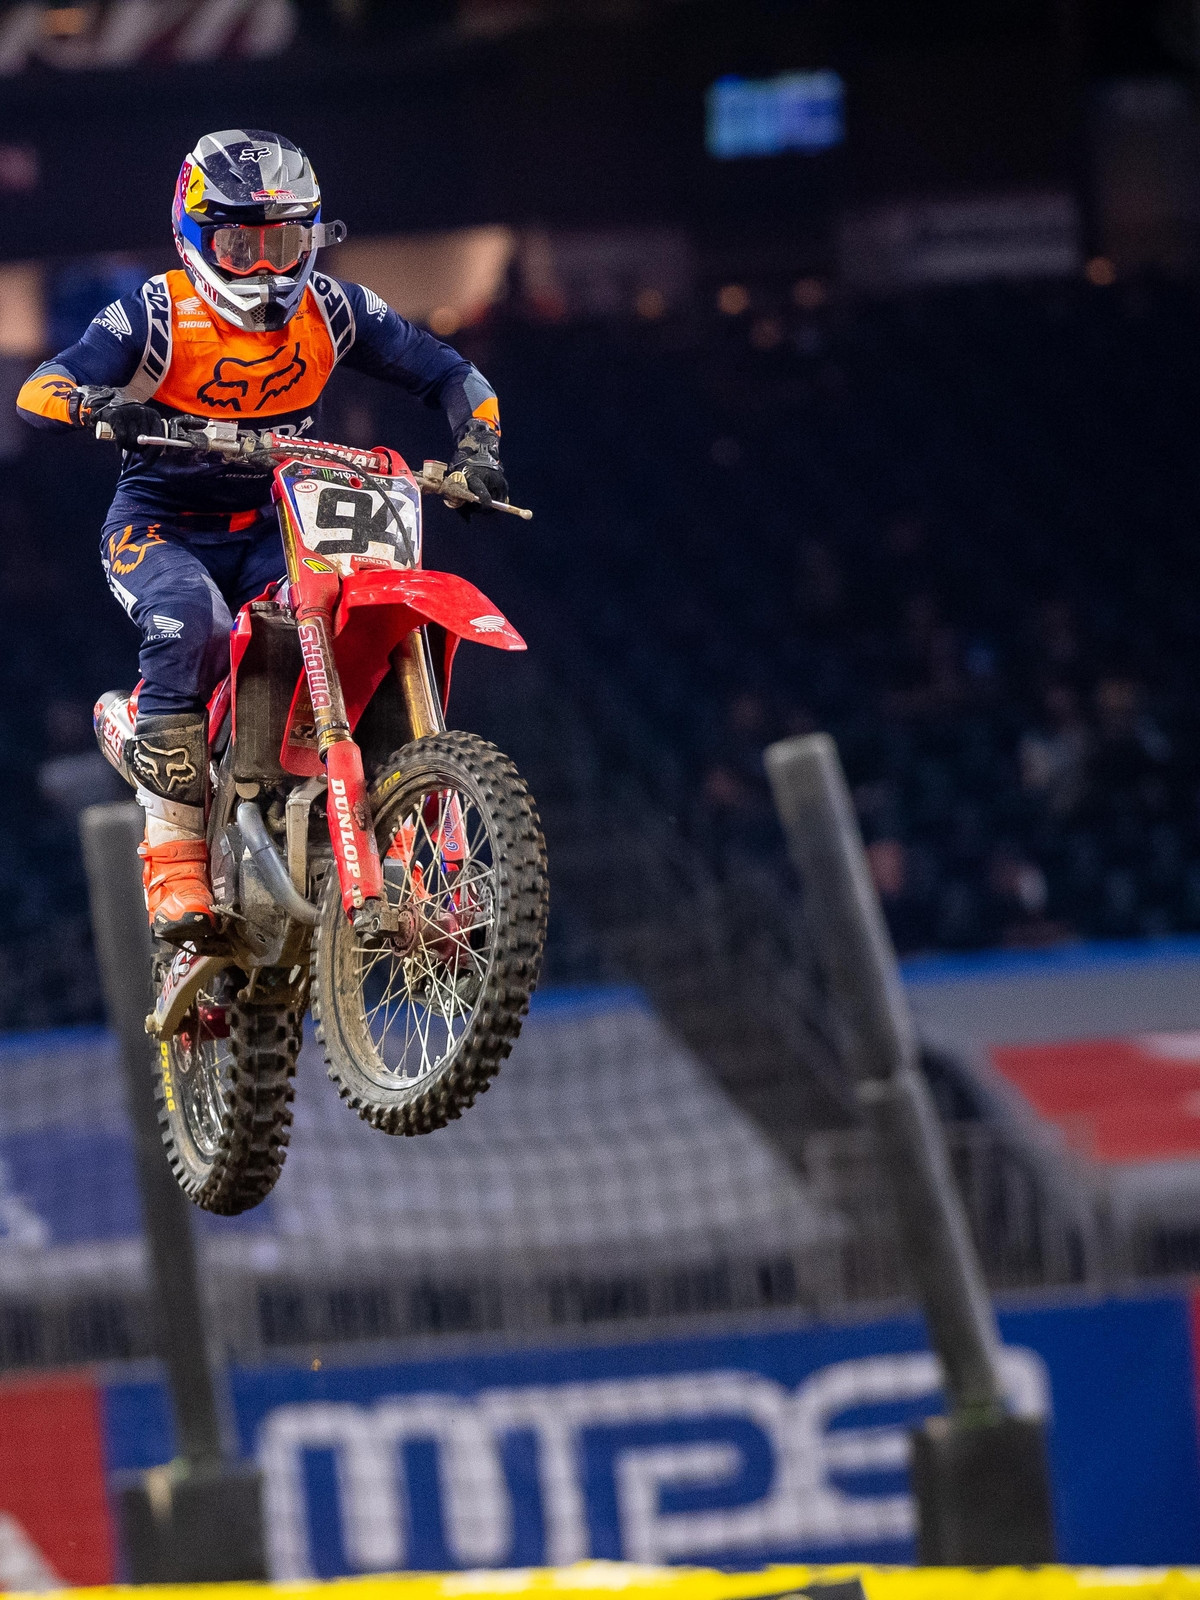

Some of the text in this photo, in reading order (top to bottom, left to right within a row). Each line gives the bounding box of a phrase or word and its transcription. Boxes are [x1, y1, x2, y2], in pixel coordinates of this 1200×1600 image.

[92, 317, 123, 342] ONDA
[177, 320, 212, 329] SHOWA
[314, 487, 416, 567] 94
[354, 556, 390, 567] HONDA
[146, 633, 182, 642] HONDA
[298, 624, 332, 711] SHOWA
[330, 778, 362, 879] DUNLOP
[160, 1041, 176, 1113] DUNLO
